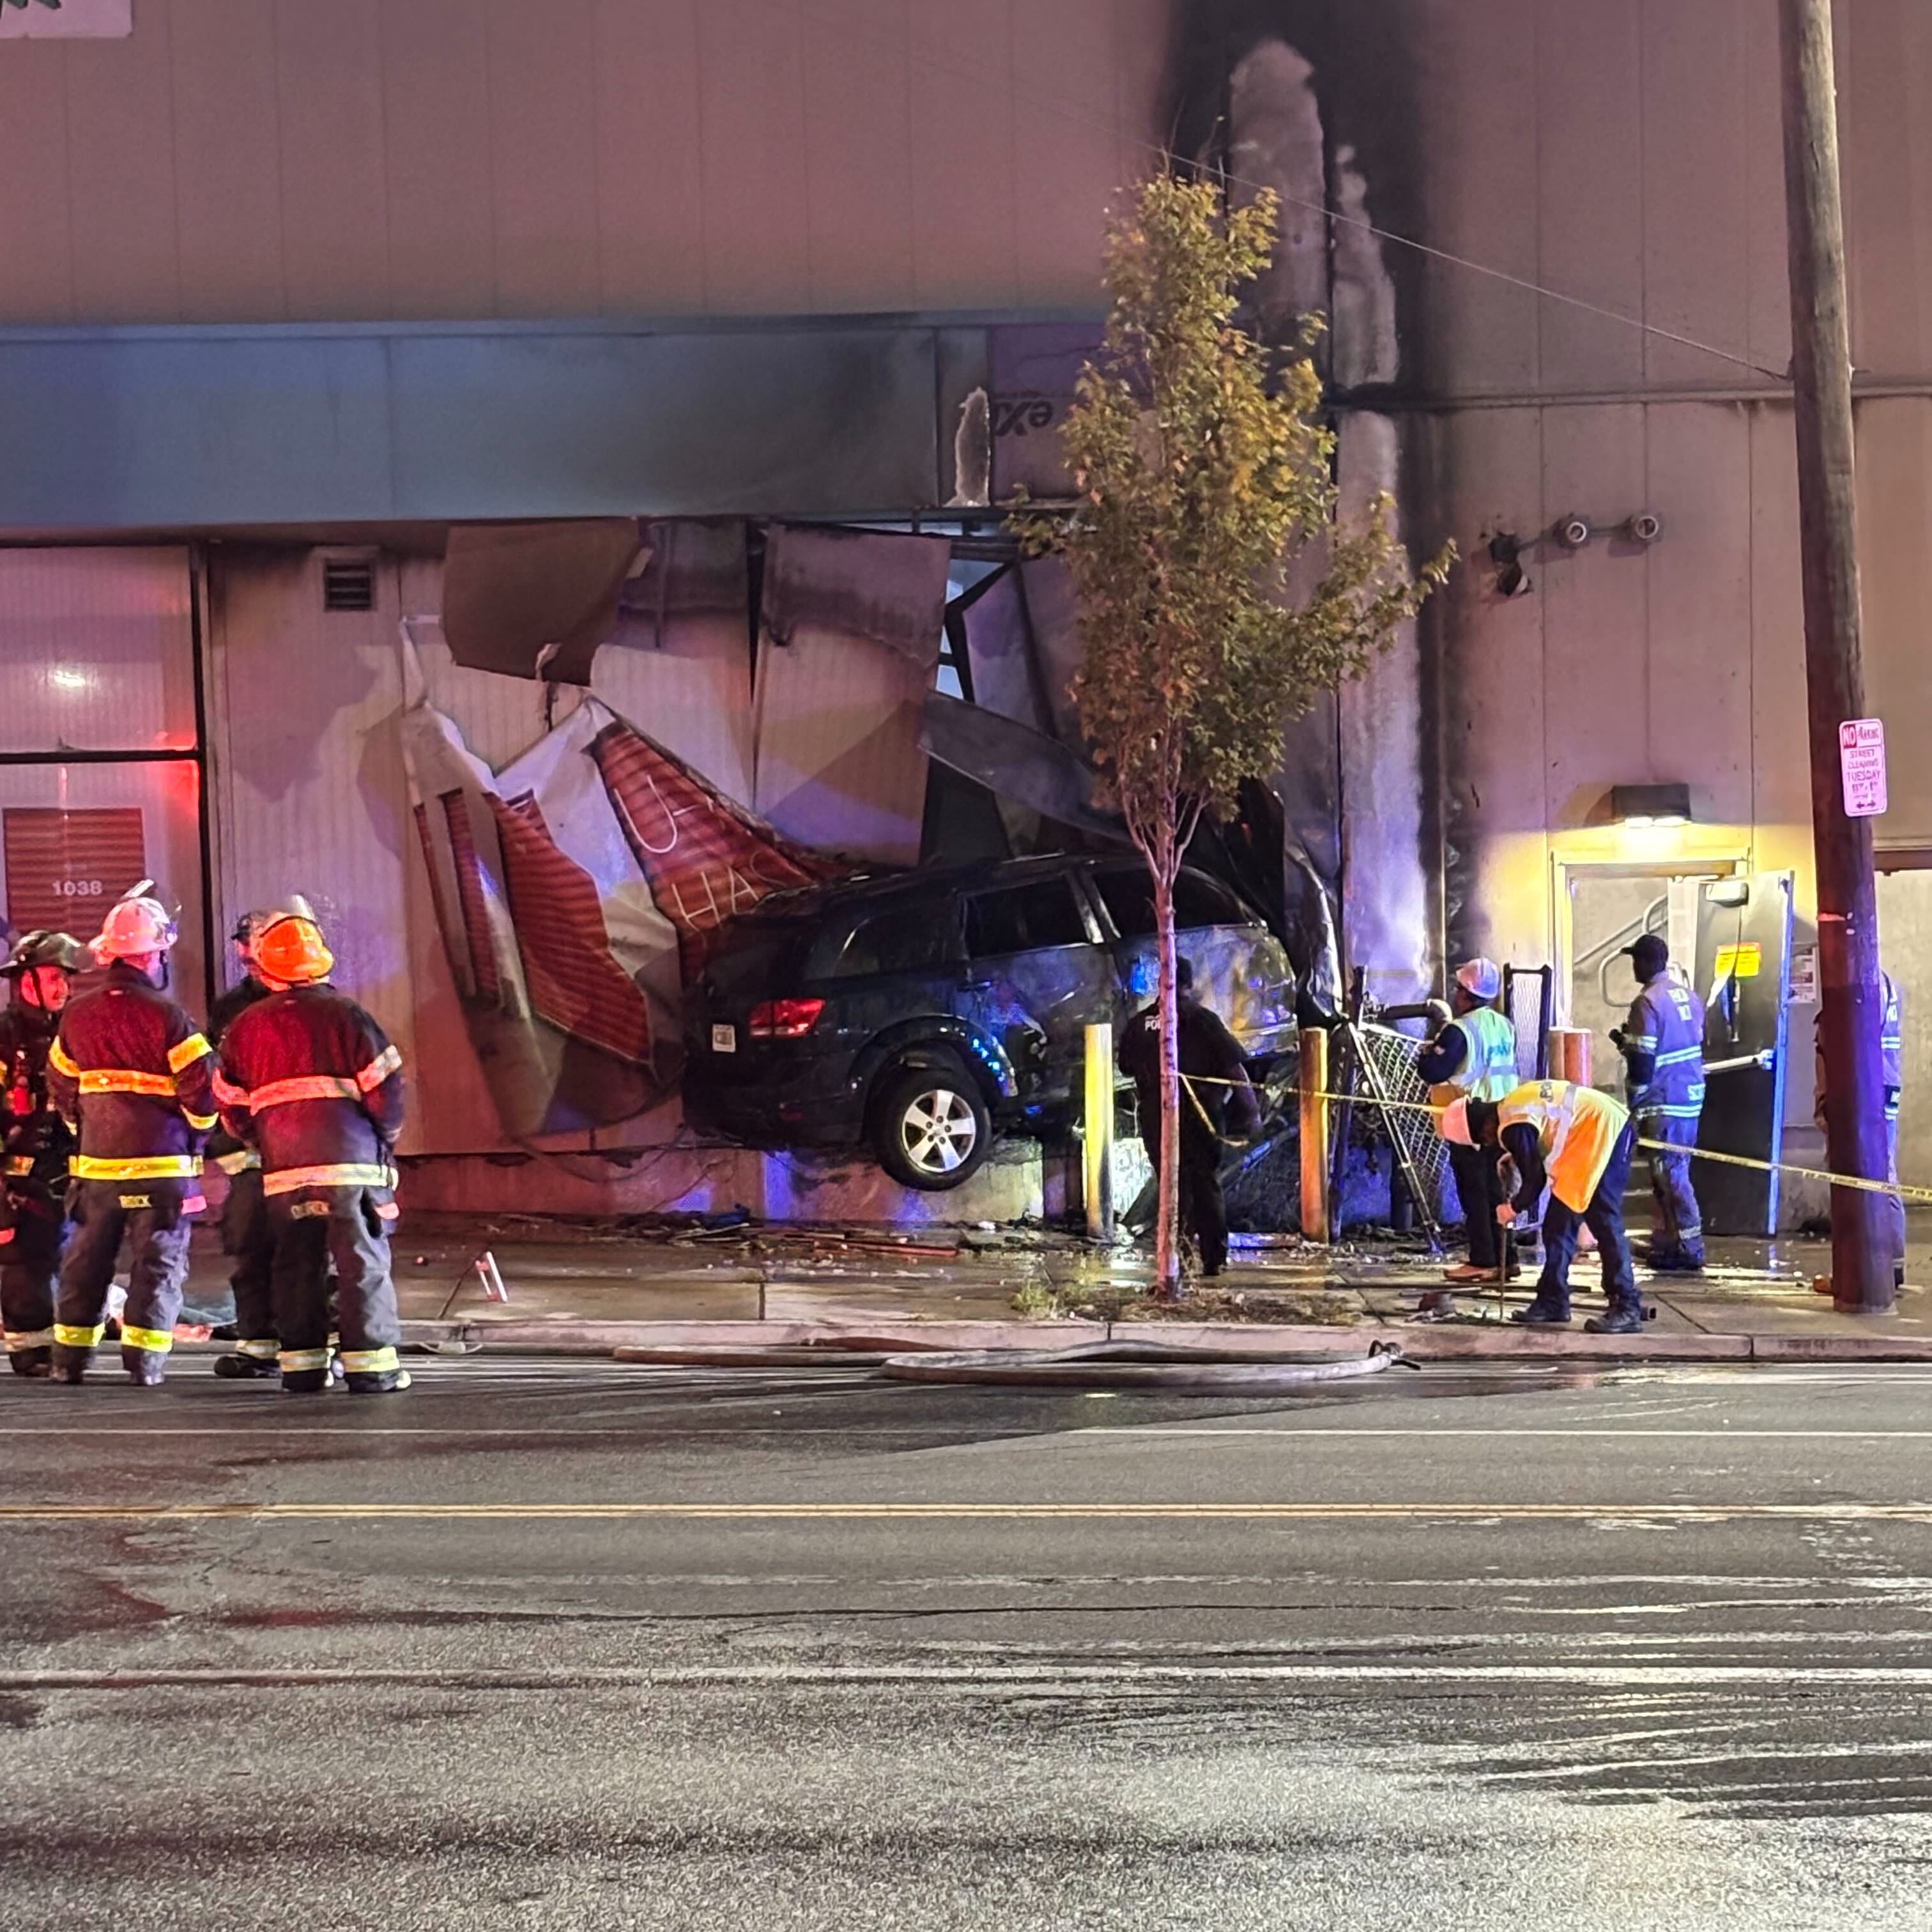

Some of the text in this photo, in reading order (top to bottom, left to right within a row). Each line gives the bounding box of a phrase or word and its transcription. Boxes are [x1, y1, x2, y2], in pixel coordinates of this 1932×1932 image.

[1843, 726, 1856, 746] NO
[1850, 749, 1874, 759] STREET
[1848, 758, 1880, 770] CLEANING
[1846, 770, 1881, 782] TUESDAY
[52, 880, 102, 896] 1038
